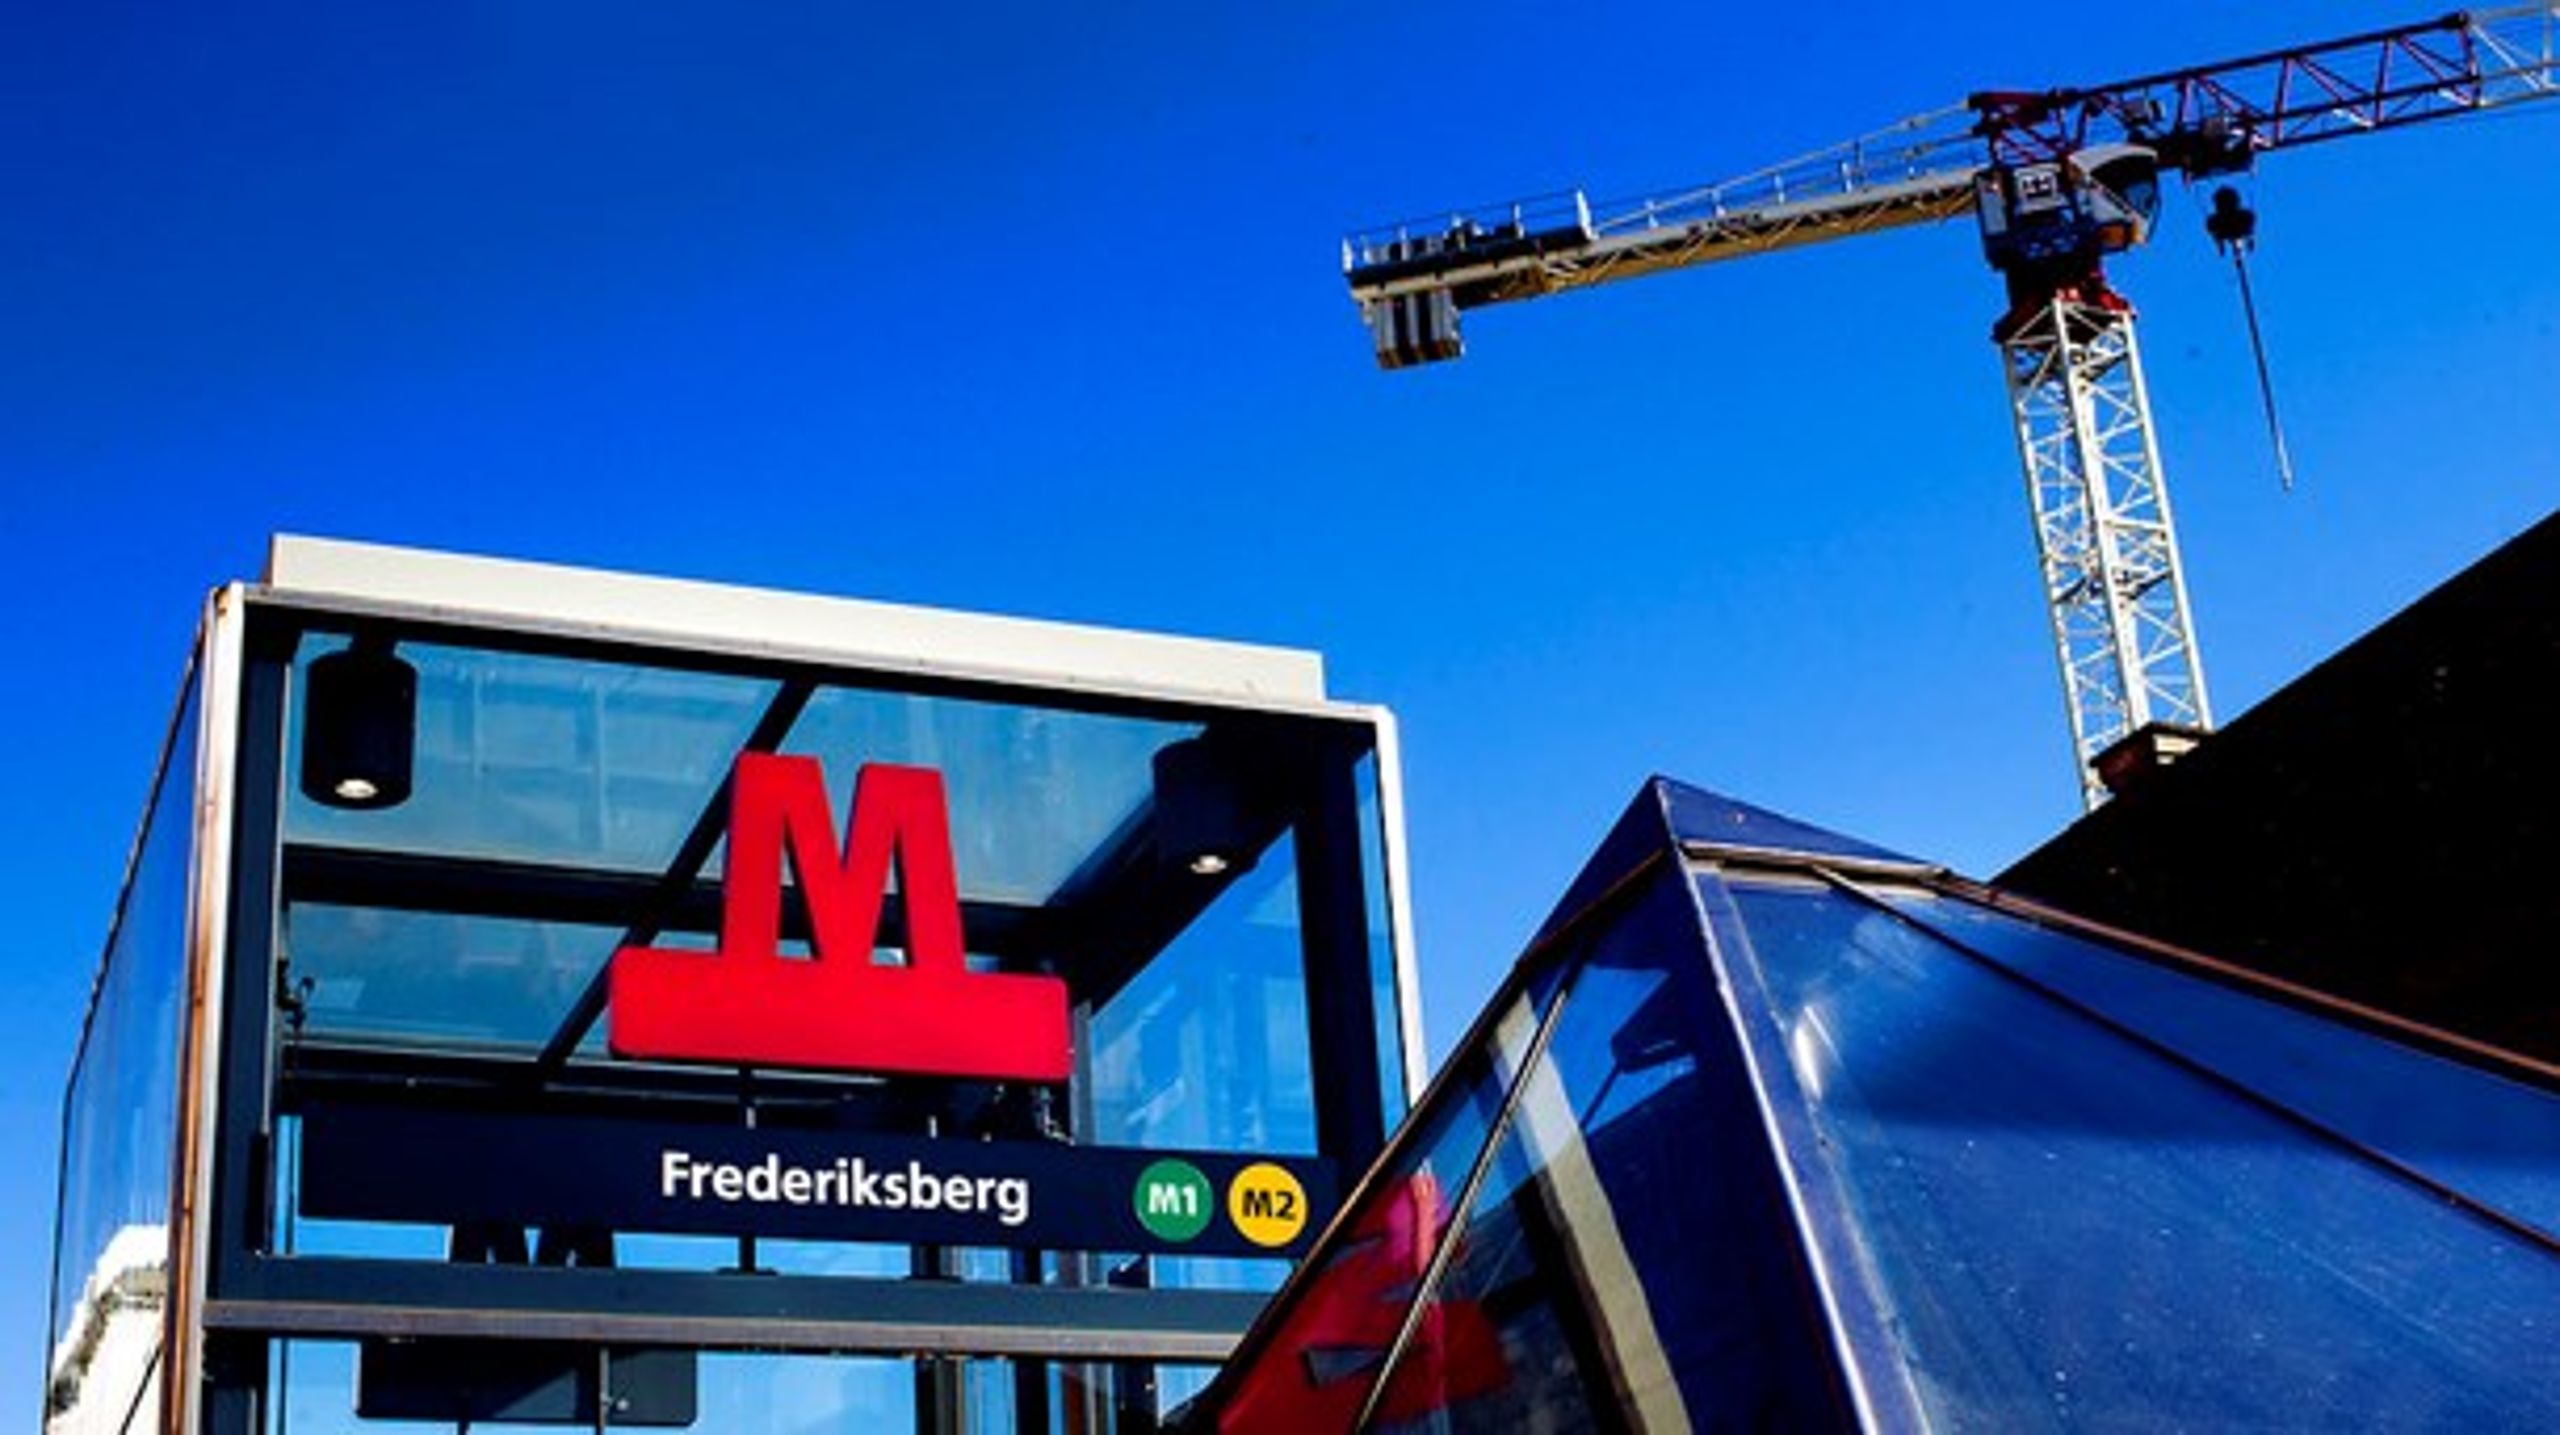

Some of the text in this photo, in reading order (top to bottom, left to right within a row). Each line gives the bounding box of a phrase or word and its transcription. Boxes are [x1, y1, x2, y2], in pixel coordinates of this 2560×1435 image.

[719, 753, 967, 972] M
[661, 1150, 1296, 1224] Frederiksberg M1 M2
